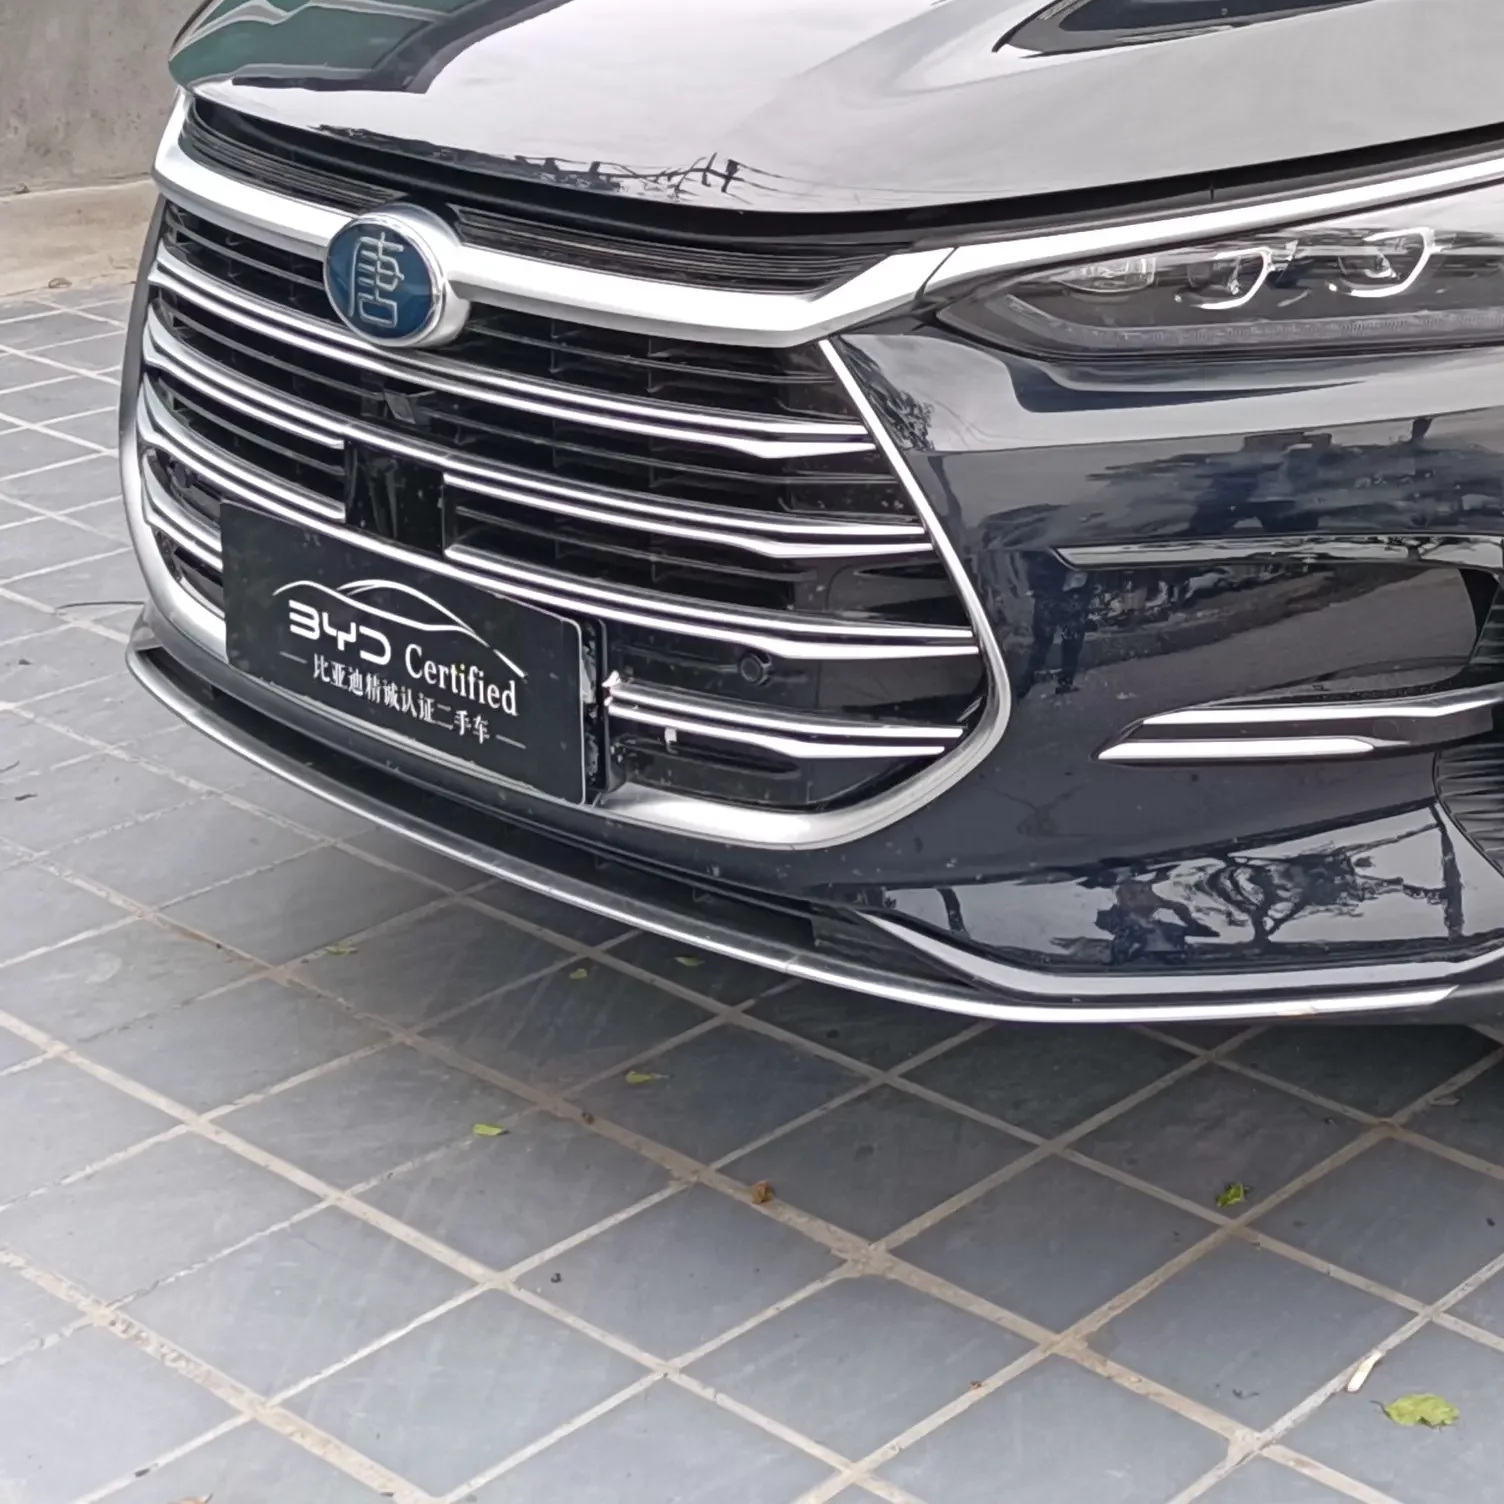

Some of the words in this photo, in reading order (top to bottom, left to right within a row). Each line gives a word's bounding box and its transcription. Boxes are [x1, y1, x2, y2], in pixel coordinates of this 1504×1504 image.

[288, 598, 392, 666] BYD
[404, 642, 519, 716] Certified
[312, 652, 491, 745] 比亚迪精诚认证二手车
